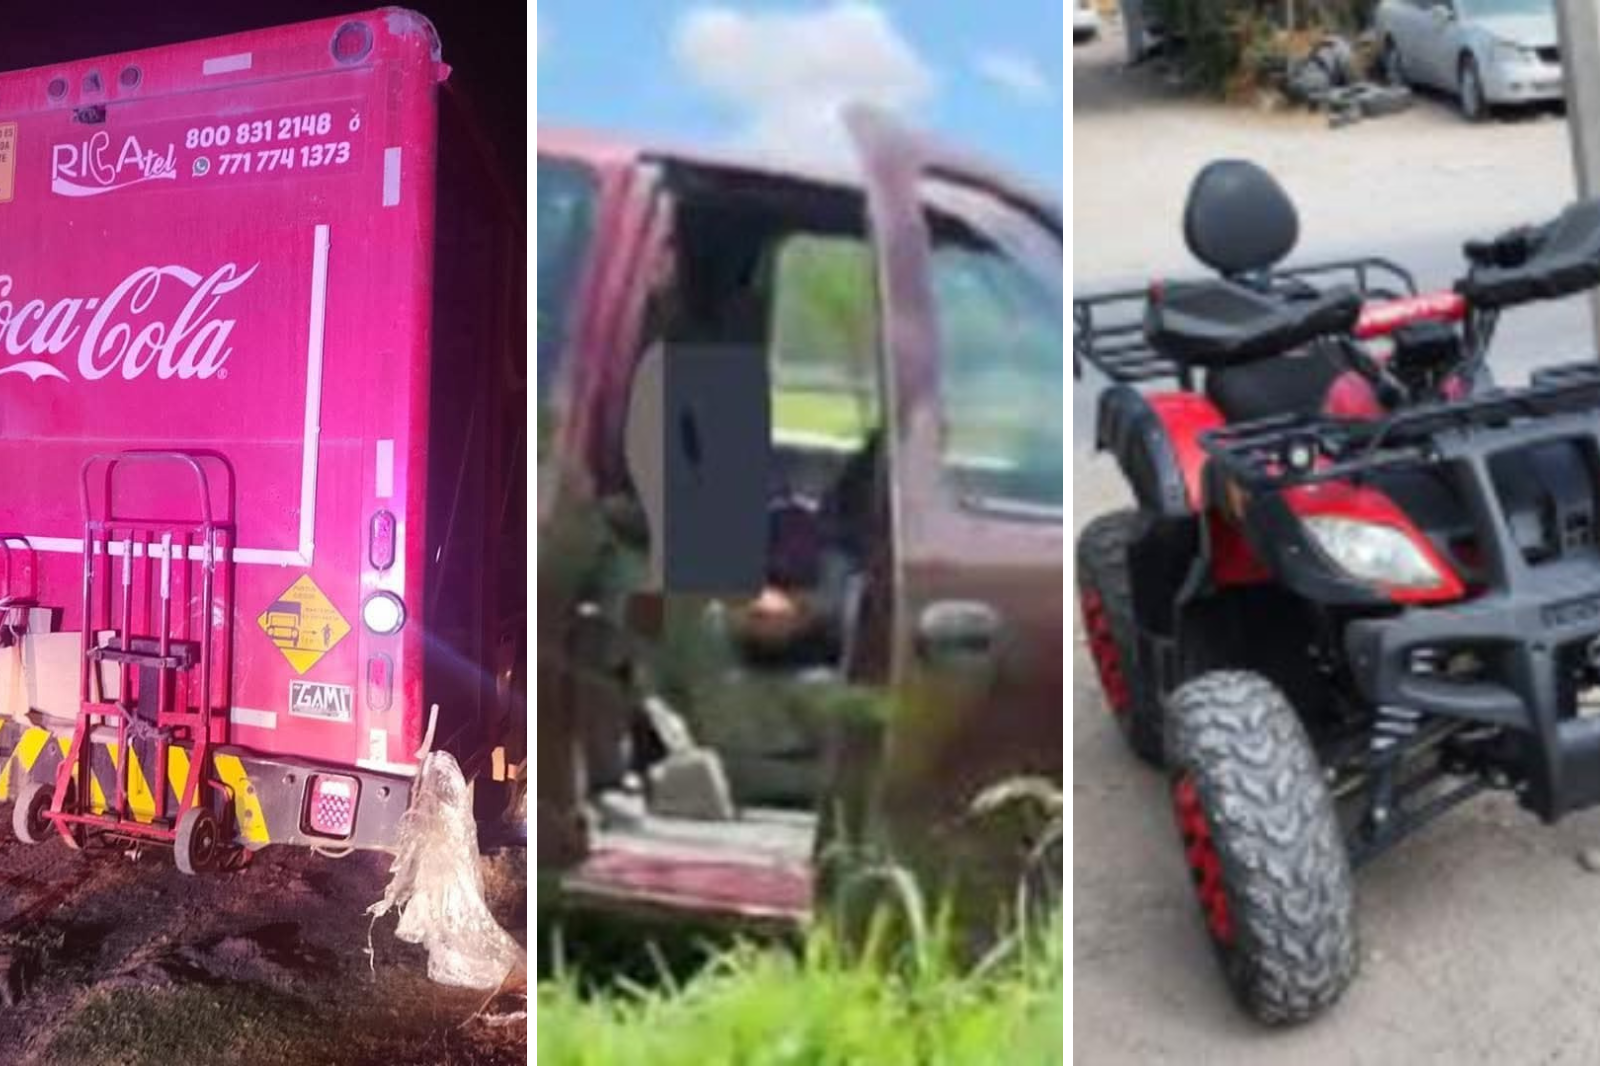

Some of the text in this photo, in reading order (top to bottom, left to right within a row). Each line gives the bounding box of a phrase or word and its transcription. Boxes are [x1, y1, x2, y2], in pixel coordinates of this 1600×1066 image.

[185, 125, 231, 149] 800
[236, 120, 273, 145] 831
[277, 112, 332, 140] 2148
[218, 141, 350, 175] 771 774 1373
